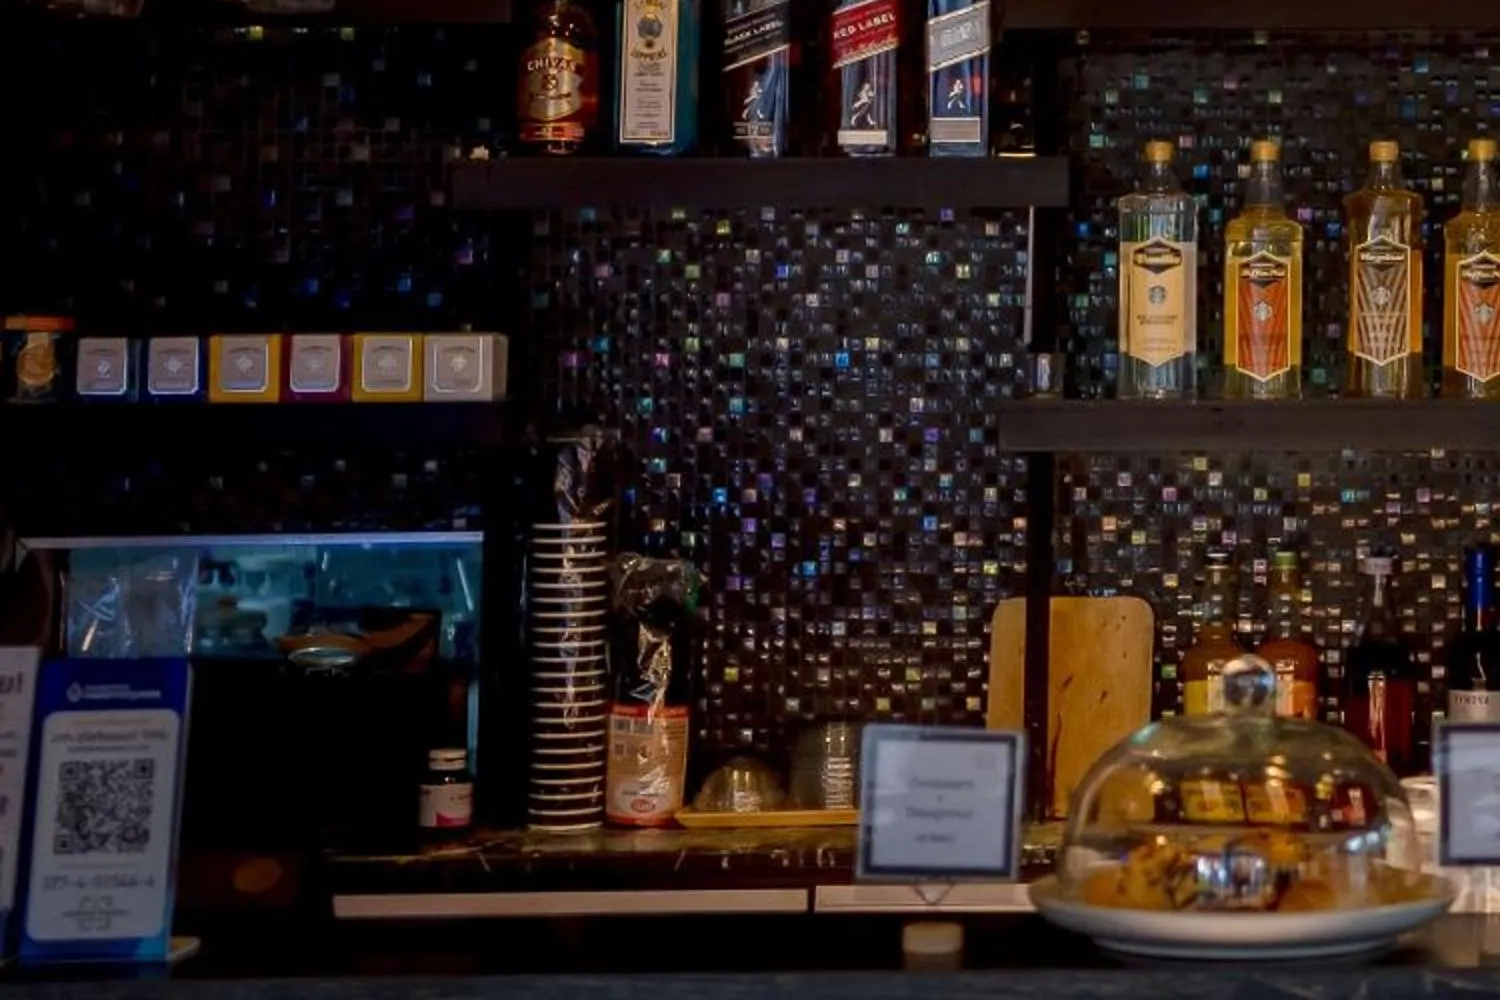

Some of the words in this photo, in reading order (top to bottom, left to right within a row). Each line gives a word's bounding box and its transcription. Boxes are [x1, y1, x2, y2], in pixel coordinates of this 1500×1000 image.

[832, 25, 857, 40] RED
[858, 12, 896, 31] LABEL
[527, 56, 578, 73] CHIVAS
